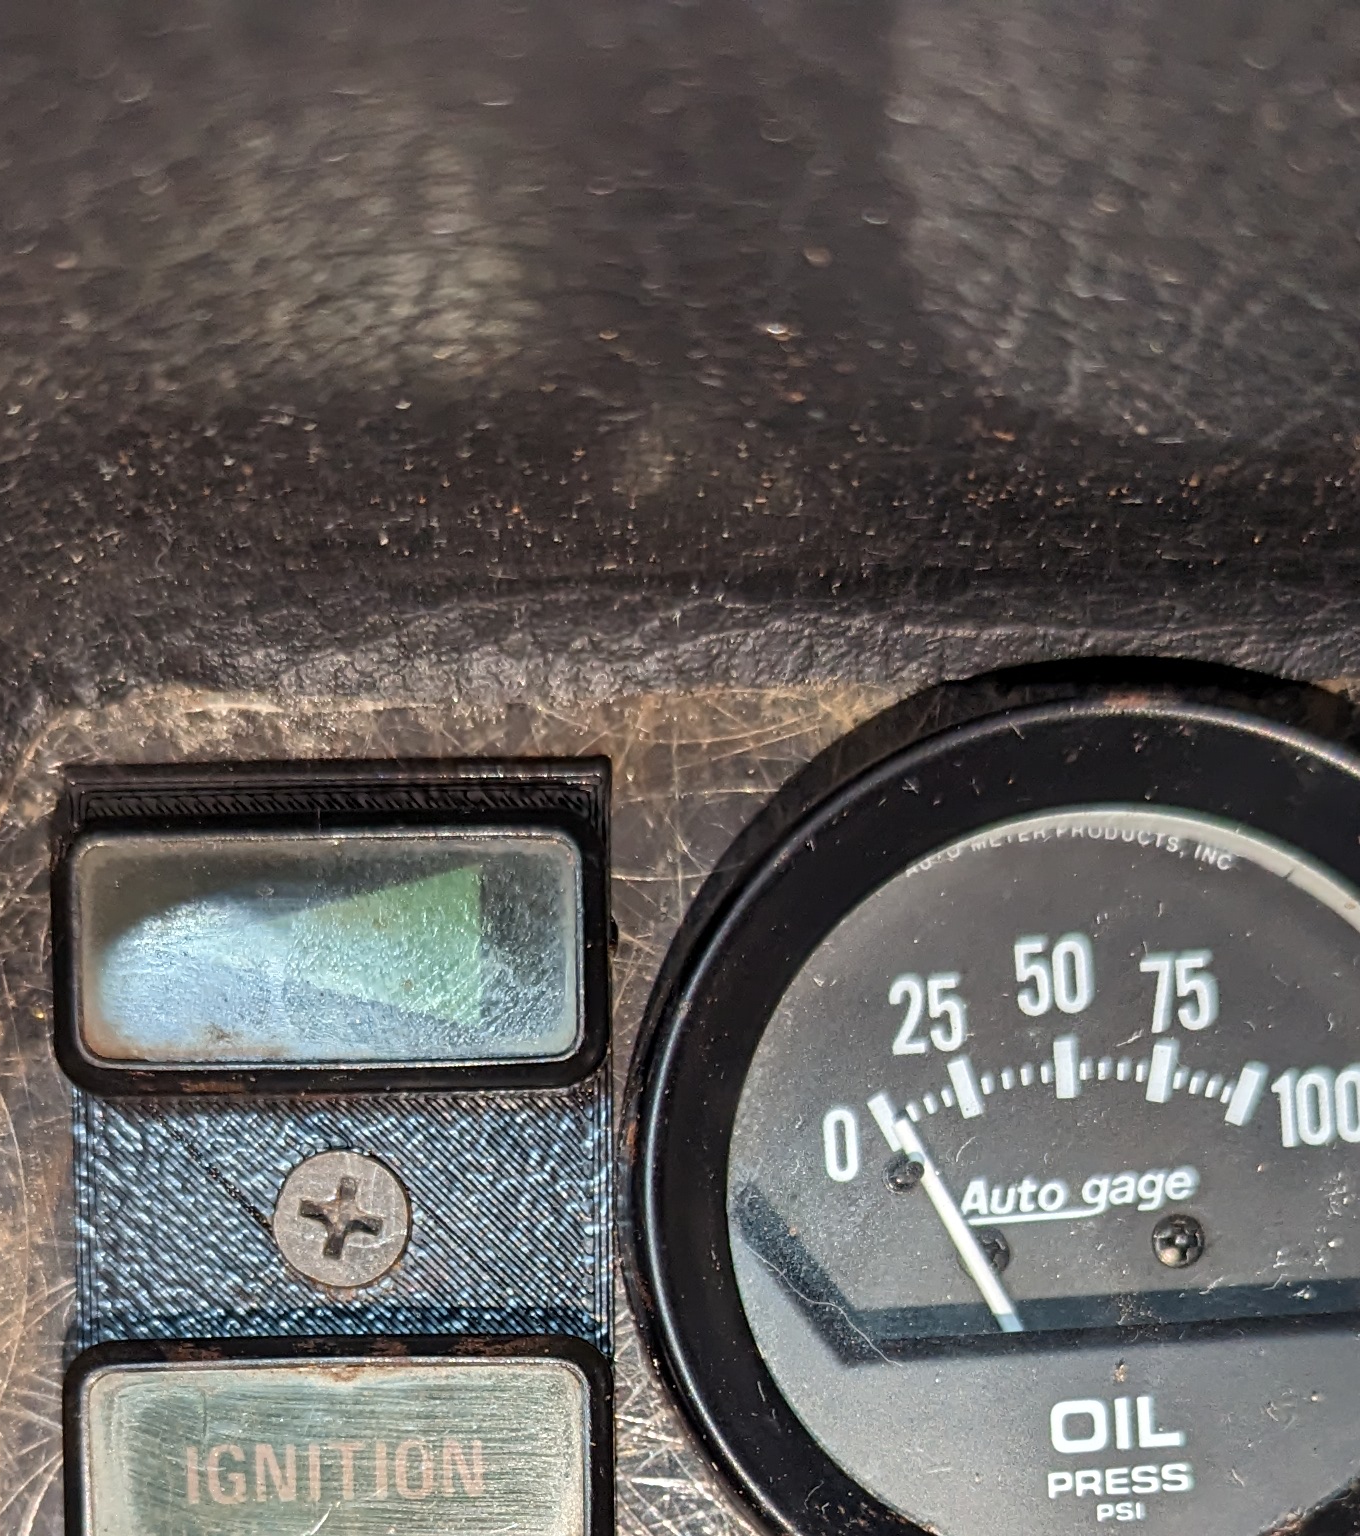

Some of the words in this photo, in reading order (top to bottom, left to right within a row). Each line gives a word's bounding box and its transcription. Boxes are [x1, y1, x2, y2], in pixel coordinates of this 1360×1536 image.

[823, 1109, 860, 1183] 0
[888, 974, 967, 1055] 25
[1013, 933, 1093, 1016] 50
[1140, 949, 1218, 1031] 75
[961, 1180, 1070, 1217] Auto
[1082, 1167, 1199, 1214] gage
[1051, 1397, 1185, 1453] OIL
[185, 1437, 486, 1507] IGNITION
[1048, 1465, 1193, 1499] PRESS
[1097, 1501, 1146, 1523] PSI
